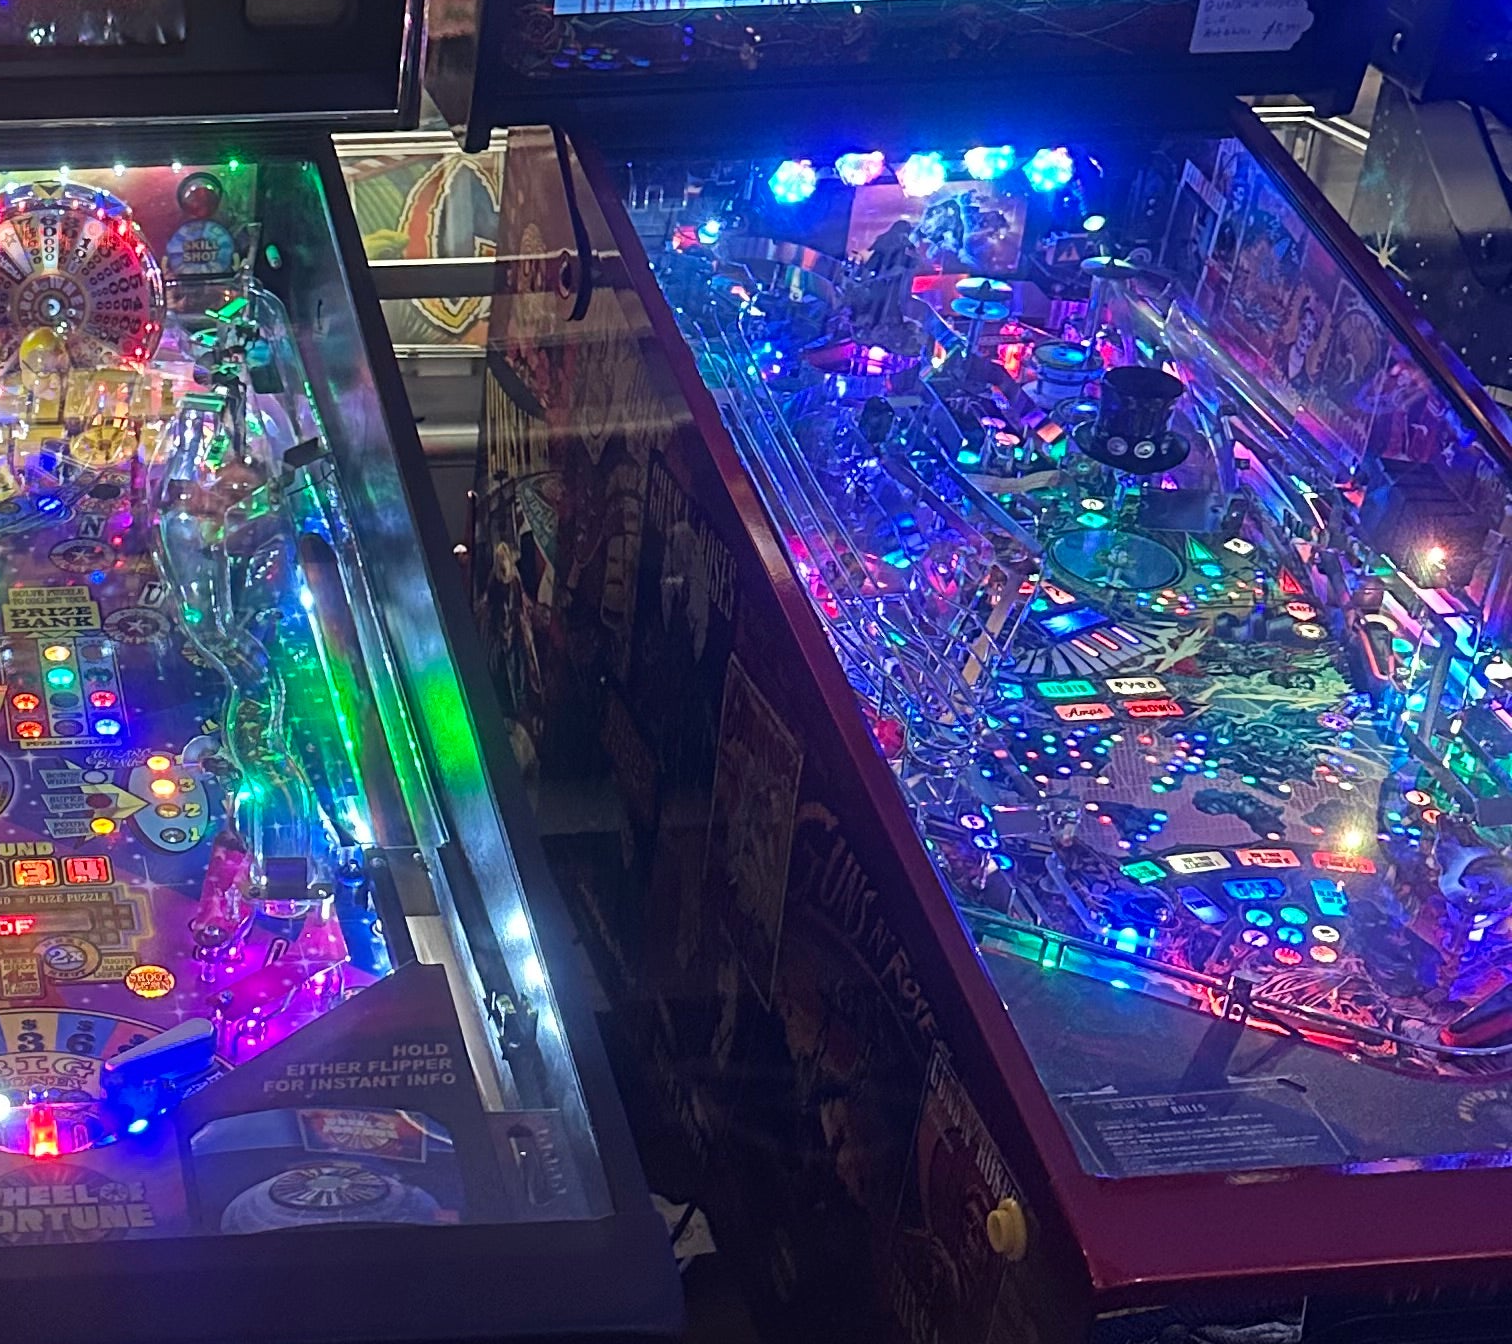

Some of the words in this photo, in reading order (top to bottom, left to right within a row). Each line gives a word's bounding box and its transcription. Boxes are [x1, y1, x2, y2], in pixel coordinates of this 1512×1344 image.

[183, 239, 220, 250] SKILL
[183, 251, 218, 263] SHOT
[9, 605, 92, 618] PRIZE
[11, 616, 95, 629] BANK
[179, 778, 196, 792] 3
[184, 803, 201, 818] 2
[189, 828, 200, 842] 1
[22, 862, 48, 883] 3
[74, 859, 101, 879] 4
[29, 893, 65, 905] PRIZE
[66, 891, 111, 903] PUZZLE
[129, 973, 171, 982] SHOOT
[393, 1043, 449, 1057] HOLD
[286, 1061, 365, 1077] EITHER
[368, 1058, 453, 1073] FLIPPER
[263, 1079, 307, 1093] FOR
[311, 1076, 401, 1091] INSTANT
[407, 1072, 456, 1086] INFO
